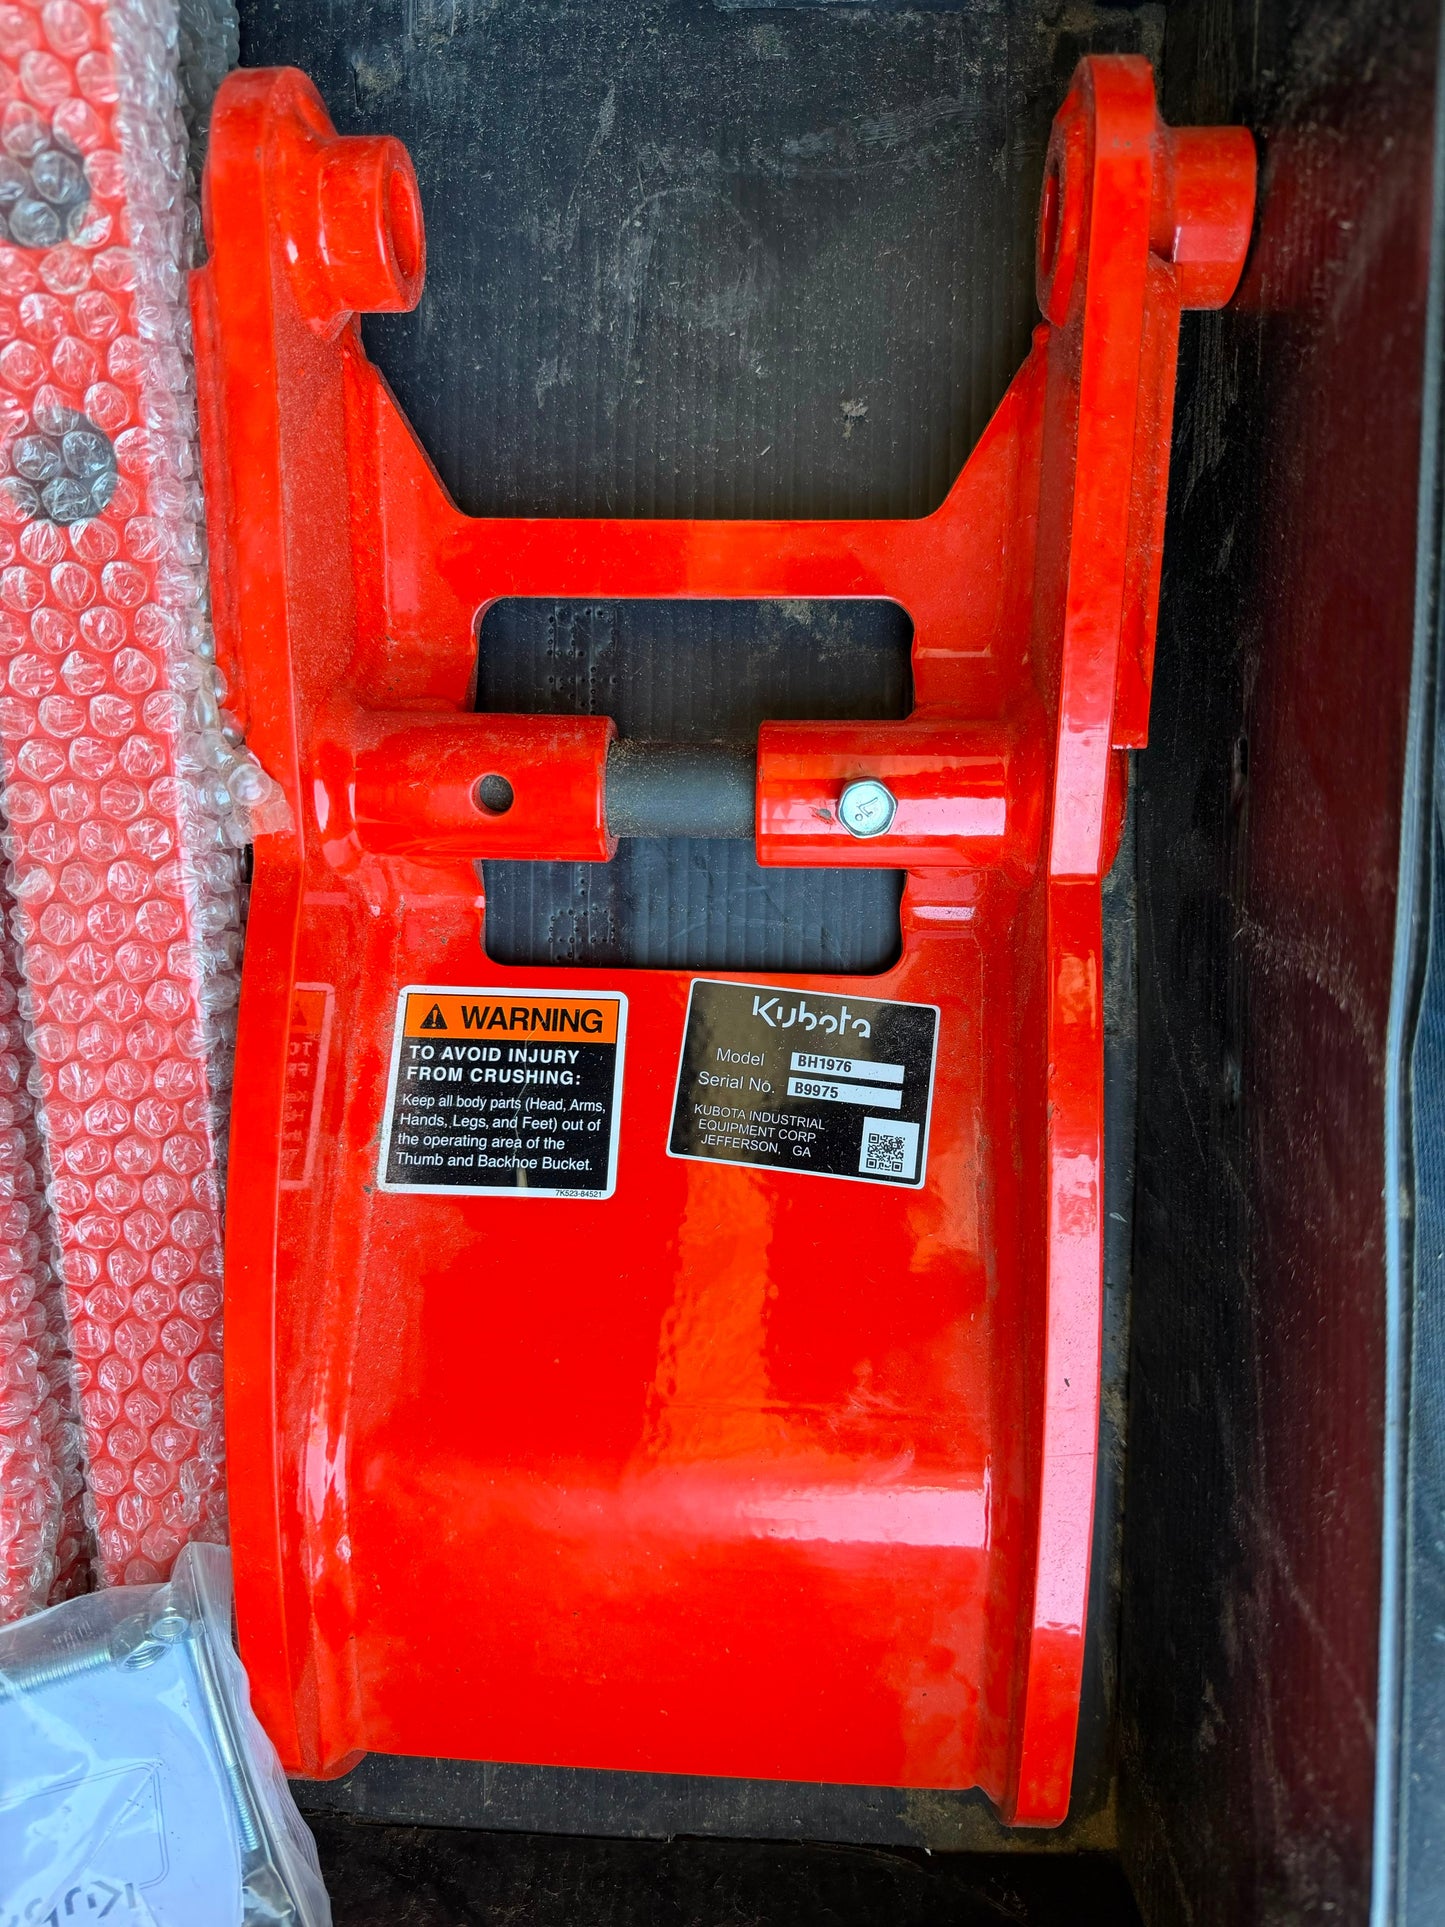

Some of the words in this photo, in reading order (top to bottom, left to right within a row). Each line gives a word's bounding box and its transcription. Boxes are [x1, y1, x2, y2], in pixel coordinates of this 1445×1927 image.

[461, 1005, 603, 1033] WARNING
[752, 995, 872, 1038] Kubota
[410, 1046, 434, 1060] TO
[441, 1047, 501, 1062] AVOID
[508, 1049, 580, 1064] INJURY
[716, 1047, 765, 1065] Model
[797, 1054, 852, 1072] BH1976
[407, 1067, 462, 1082] FROM
[470, 1069, 581, 1085] CRUSHING:
[698, 1071, 743, 1089] Serial
[748, 1077, 775, 1094] No.
[795, 1082, 839, 1099] B9975
[402, 1094, 435, 1110] Keep
[439, 1095, 453, 1106] all
[457, 1096, 487, 1111] body
[490, 1097, 521, 1112] parts
[525, 1097, 566, 1112] (Head,
[569, 1099, 606, 1113] Arms,
[400, 1114, 448, 1129] Hands,
[453, 1116, 489, 1131] Legs,
[493, 1117, 517, 1128] and
[522, 1117, 557, 1132] Feet)
[562, 1119, 583, 1131] out
[587, 1119, 602, 1131] of
[694, 1104, 747, 1119] KUBOTA
[749, 1110, 825, 1130] INDUSTRIAL
[398, 1133, 419, 1145] the
[424, 1135, 487, 1150] operating
[491, 1137, 522, 1148] area
[527, 1136, 540, 1149] of
[543, 1137, 565, 1149] the
[698, 1119, 775, 1138] EQUIPMENT
[778, 1129, 817, 1144] CORP.
[700, 1134, 781, 1154] JEFFERSON,
[792, 1146, 811, 1157] GA
[396, 1152, 443, 1166] Thumb
[448, 1155, 473, 1167] and
[478, 1155, 537, 1169] Backhoe
[542, 1157, 593, 1170] Bucket.
[555, 1190, 602, 1198] 7K523-84521
